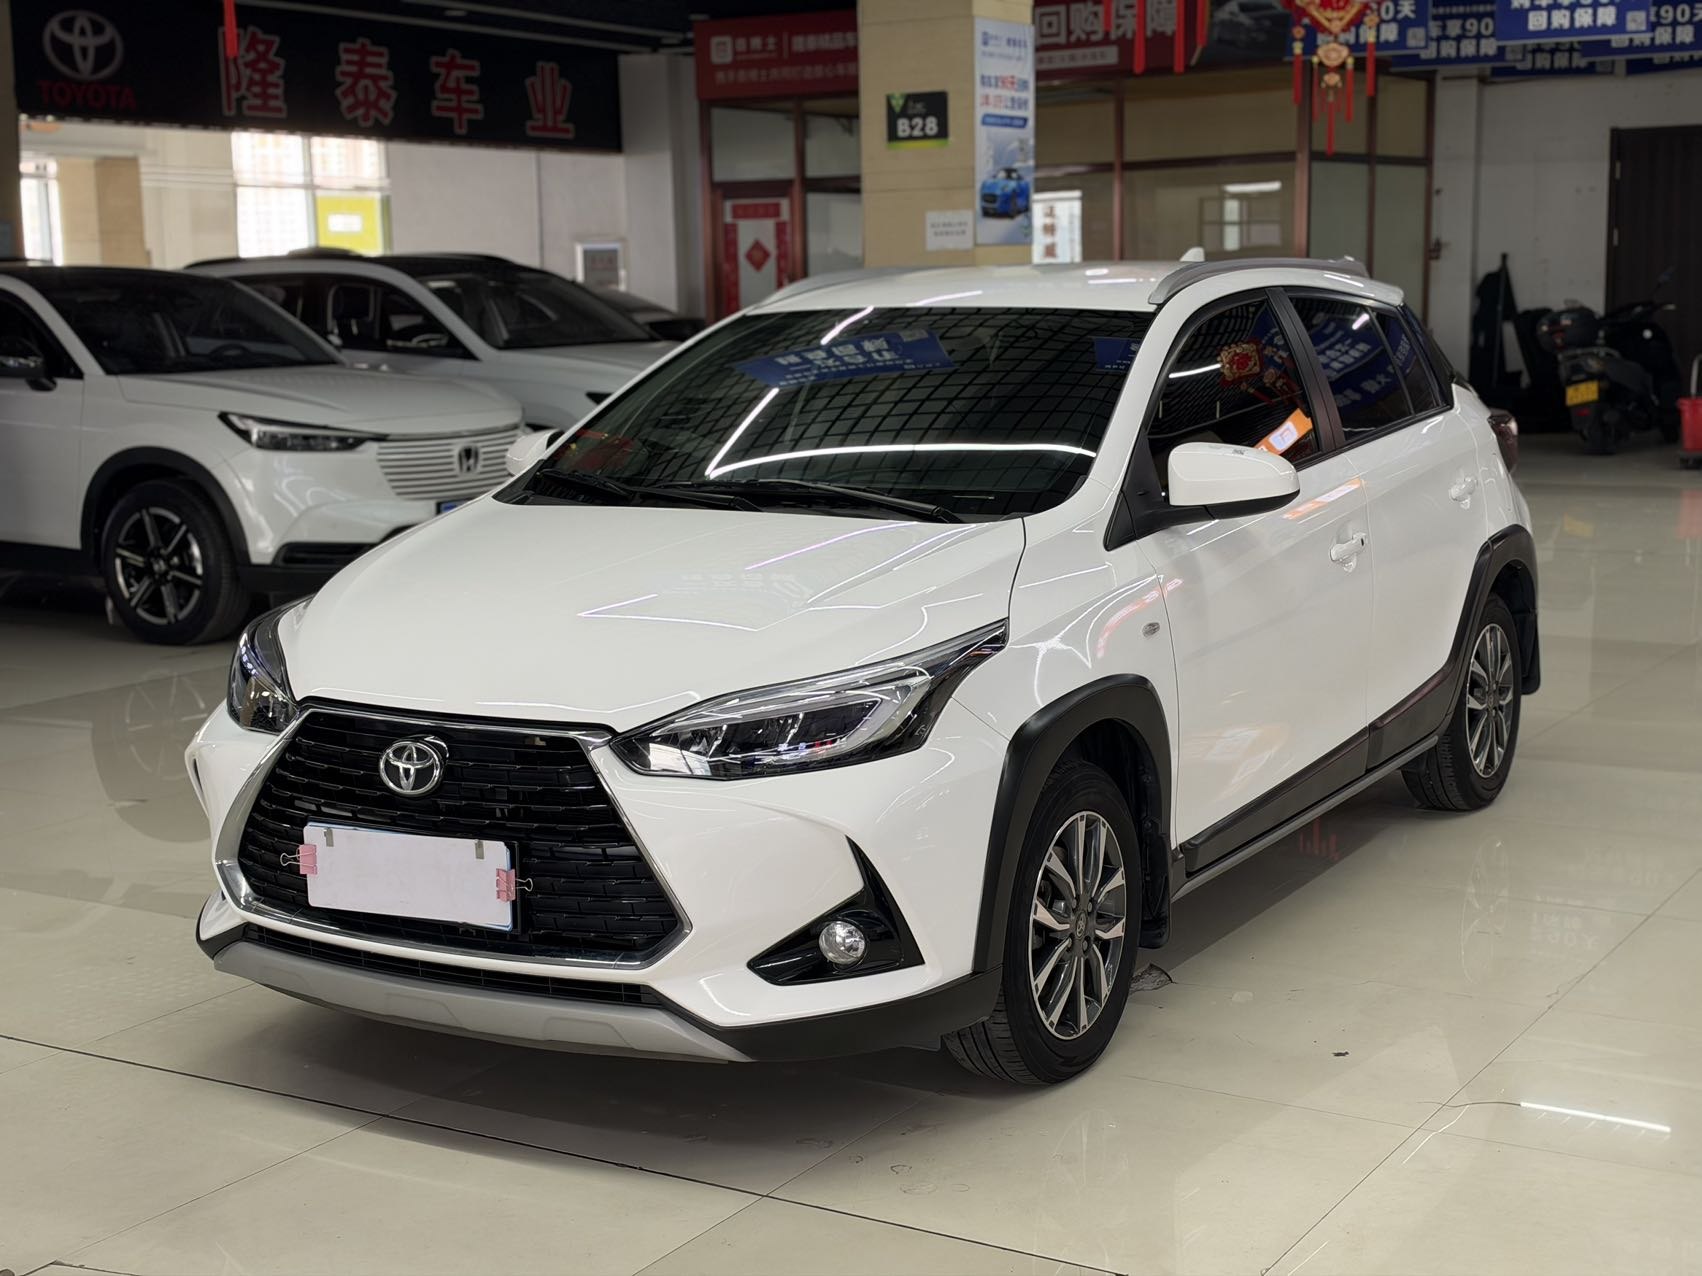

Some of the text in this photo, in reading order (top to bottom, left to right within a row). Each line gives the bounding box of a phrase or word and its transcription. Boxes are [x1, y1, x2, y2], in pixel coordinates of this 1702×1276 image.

[1527, 6, 1617, 32] 回购保障
[36, 80, 137, 111] TOYOTA
[218, 24, 576, 140] 隆泰车业
[896, 115, 939, 138] B28
